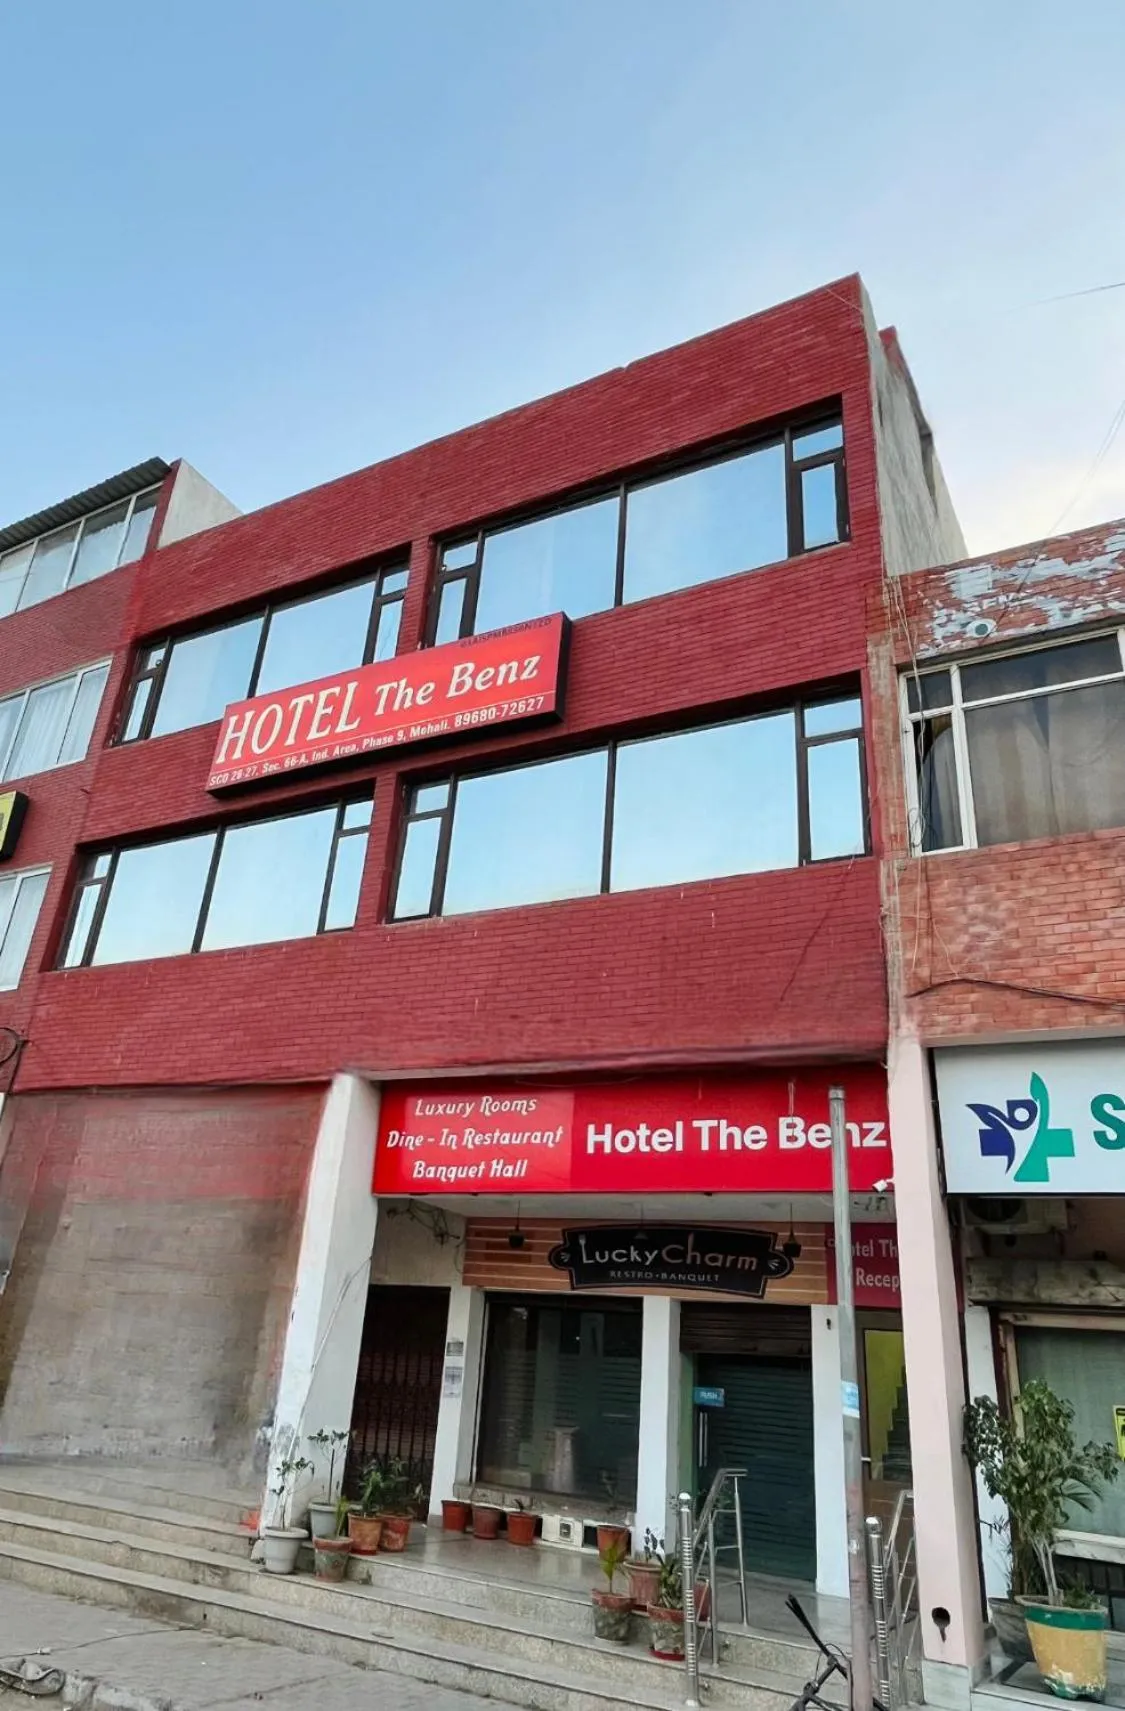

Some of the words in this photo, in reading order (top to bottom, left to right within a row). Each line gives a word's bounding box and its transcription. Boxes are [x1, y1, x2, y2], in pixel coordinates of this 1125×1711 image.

[216, 681, 361, 764] HOTEL
[374, 677, 436, 716] The
[446, 655, 541, 698] Benz
[362, 735, 394, 750] Phase
[454, 696, 545, 728] 89680-72627
[415, 1099, 475, 1118] Luxury
[479, 1095, 537, 1117] Rooms
[387, 1130, 424, 1150] Dine
[439, 1128, 457, 1150] In
[462, 1125, 564, 1150] Restaurant
[587, 1121, 683, 1154] Hotel
[692, 1119, 768, 1150] The
[778, 1116, 887, 1149] Benz
[412, 1160, 485, 1183] Banquet
[489, 1159, 528, 1178] Hall
